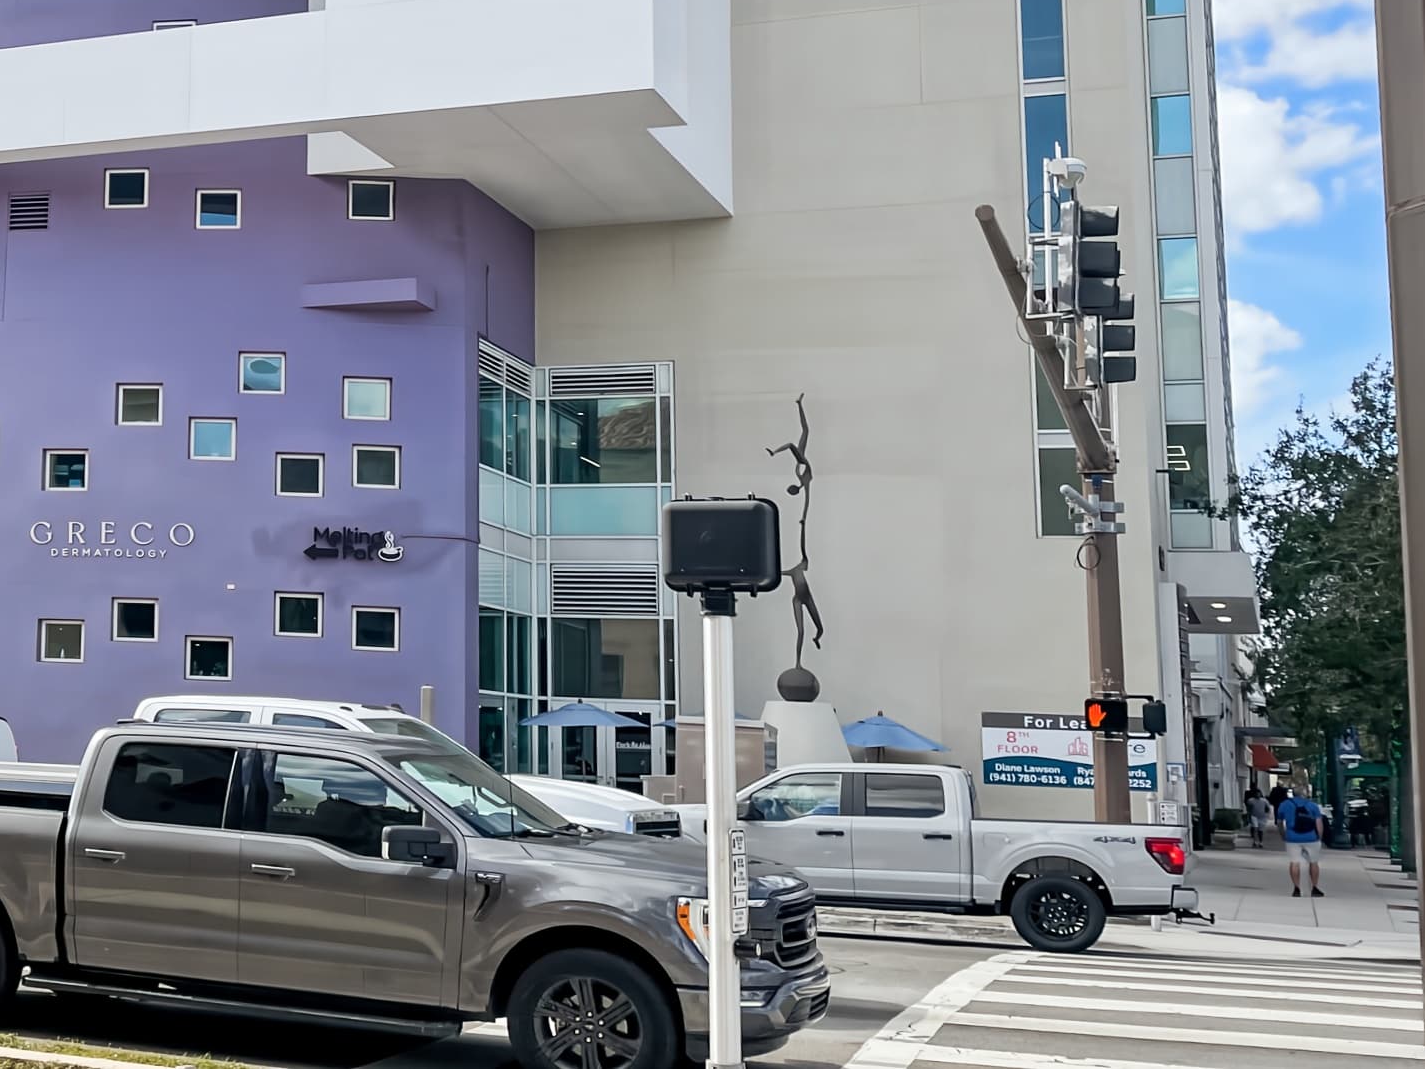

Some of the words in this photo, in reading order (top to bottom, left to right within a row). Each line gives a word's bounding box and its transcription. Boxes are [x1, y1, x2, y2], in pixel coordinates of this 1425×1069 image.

[29, 521, 195, 546] GRECO
[313, 526, 383, 548] Melting
[50, 548, 167, 558] DERMATOLOGY
[342, 545, 375, 560] Pot
[1023, 715, 1053, 729] For
[1059, 716, 1087, 730] Lea
[997, 744, 1039, 754] FLOOR
[995, 763, 1022, 773] Diane
[1024, 764, 1061, 775] Lawson
[1077, 767, 1094, 778] Rya
[989, 772, 1016, 783] (941)
[1018, 773, 1067, 784] 780-6136
[1073, 776, 1094, 787] (847
